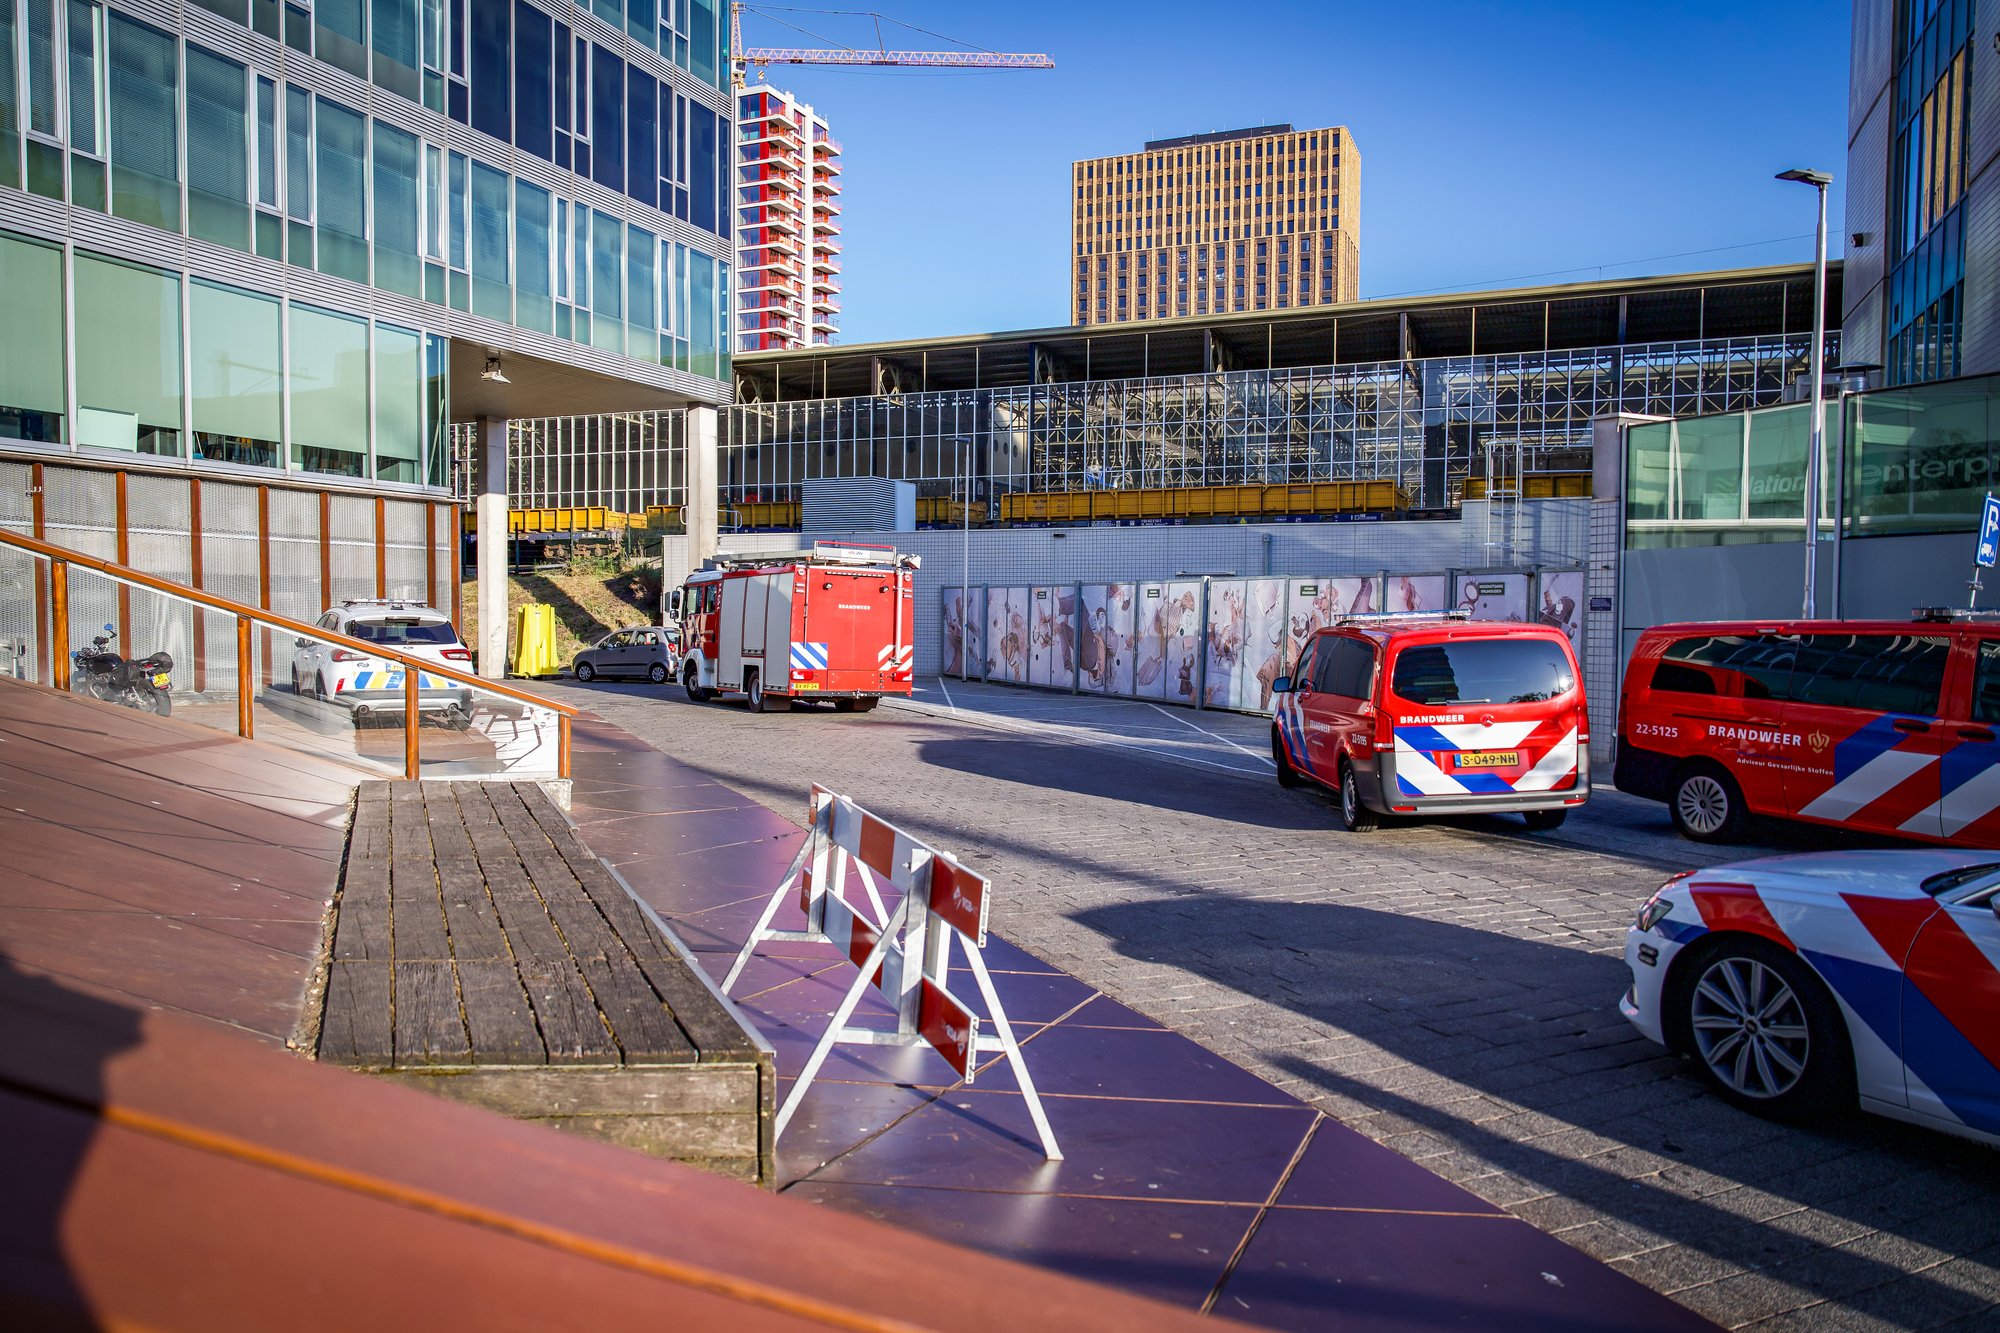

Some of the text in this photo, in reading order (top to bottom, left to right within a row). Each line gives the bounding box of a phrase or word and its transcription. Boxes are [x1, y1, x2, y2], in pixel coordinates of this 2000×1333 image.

[1750, 474, 1805, 495] ation
[1400, 714, 1464, 724] BRANDWEER
[1635, 723, 1678, 738] 22-5125
[1708, 724, 1802, 747] BRANDWEER
[1463, 753, 1516, 766] S-049-NH
[1736, 757, 1765, 767] Adviseur
[1807, 767, 1834, 776] Stoffen
